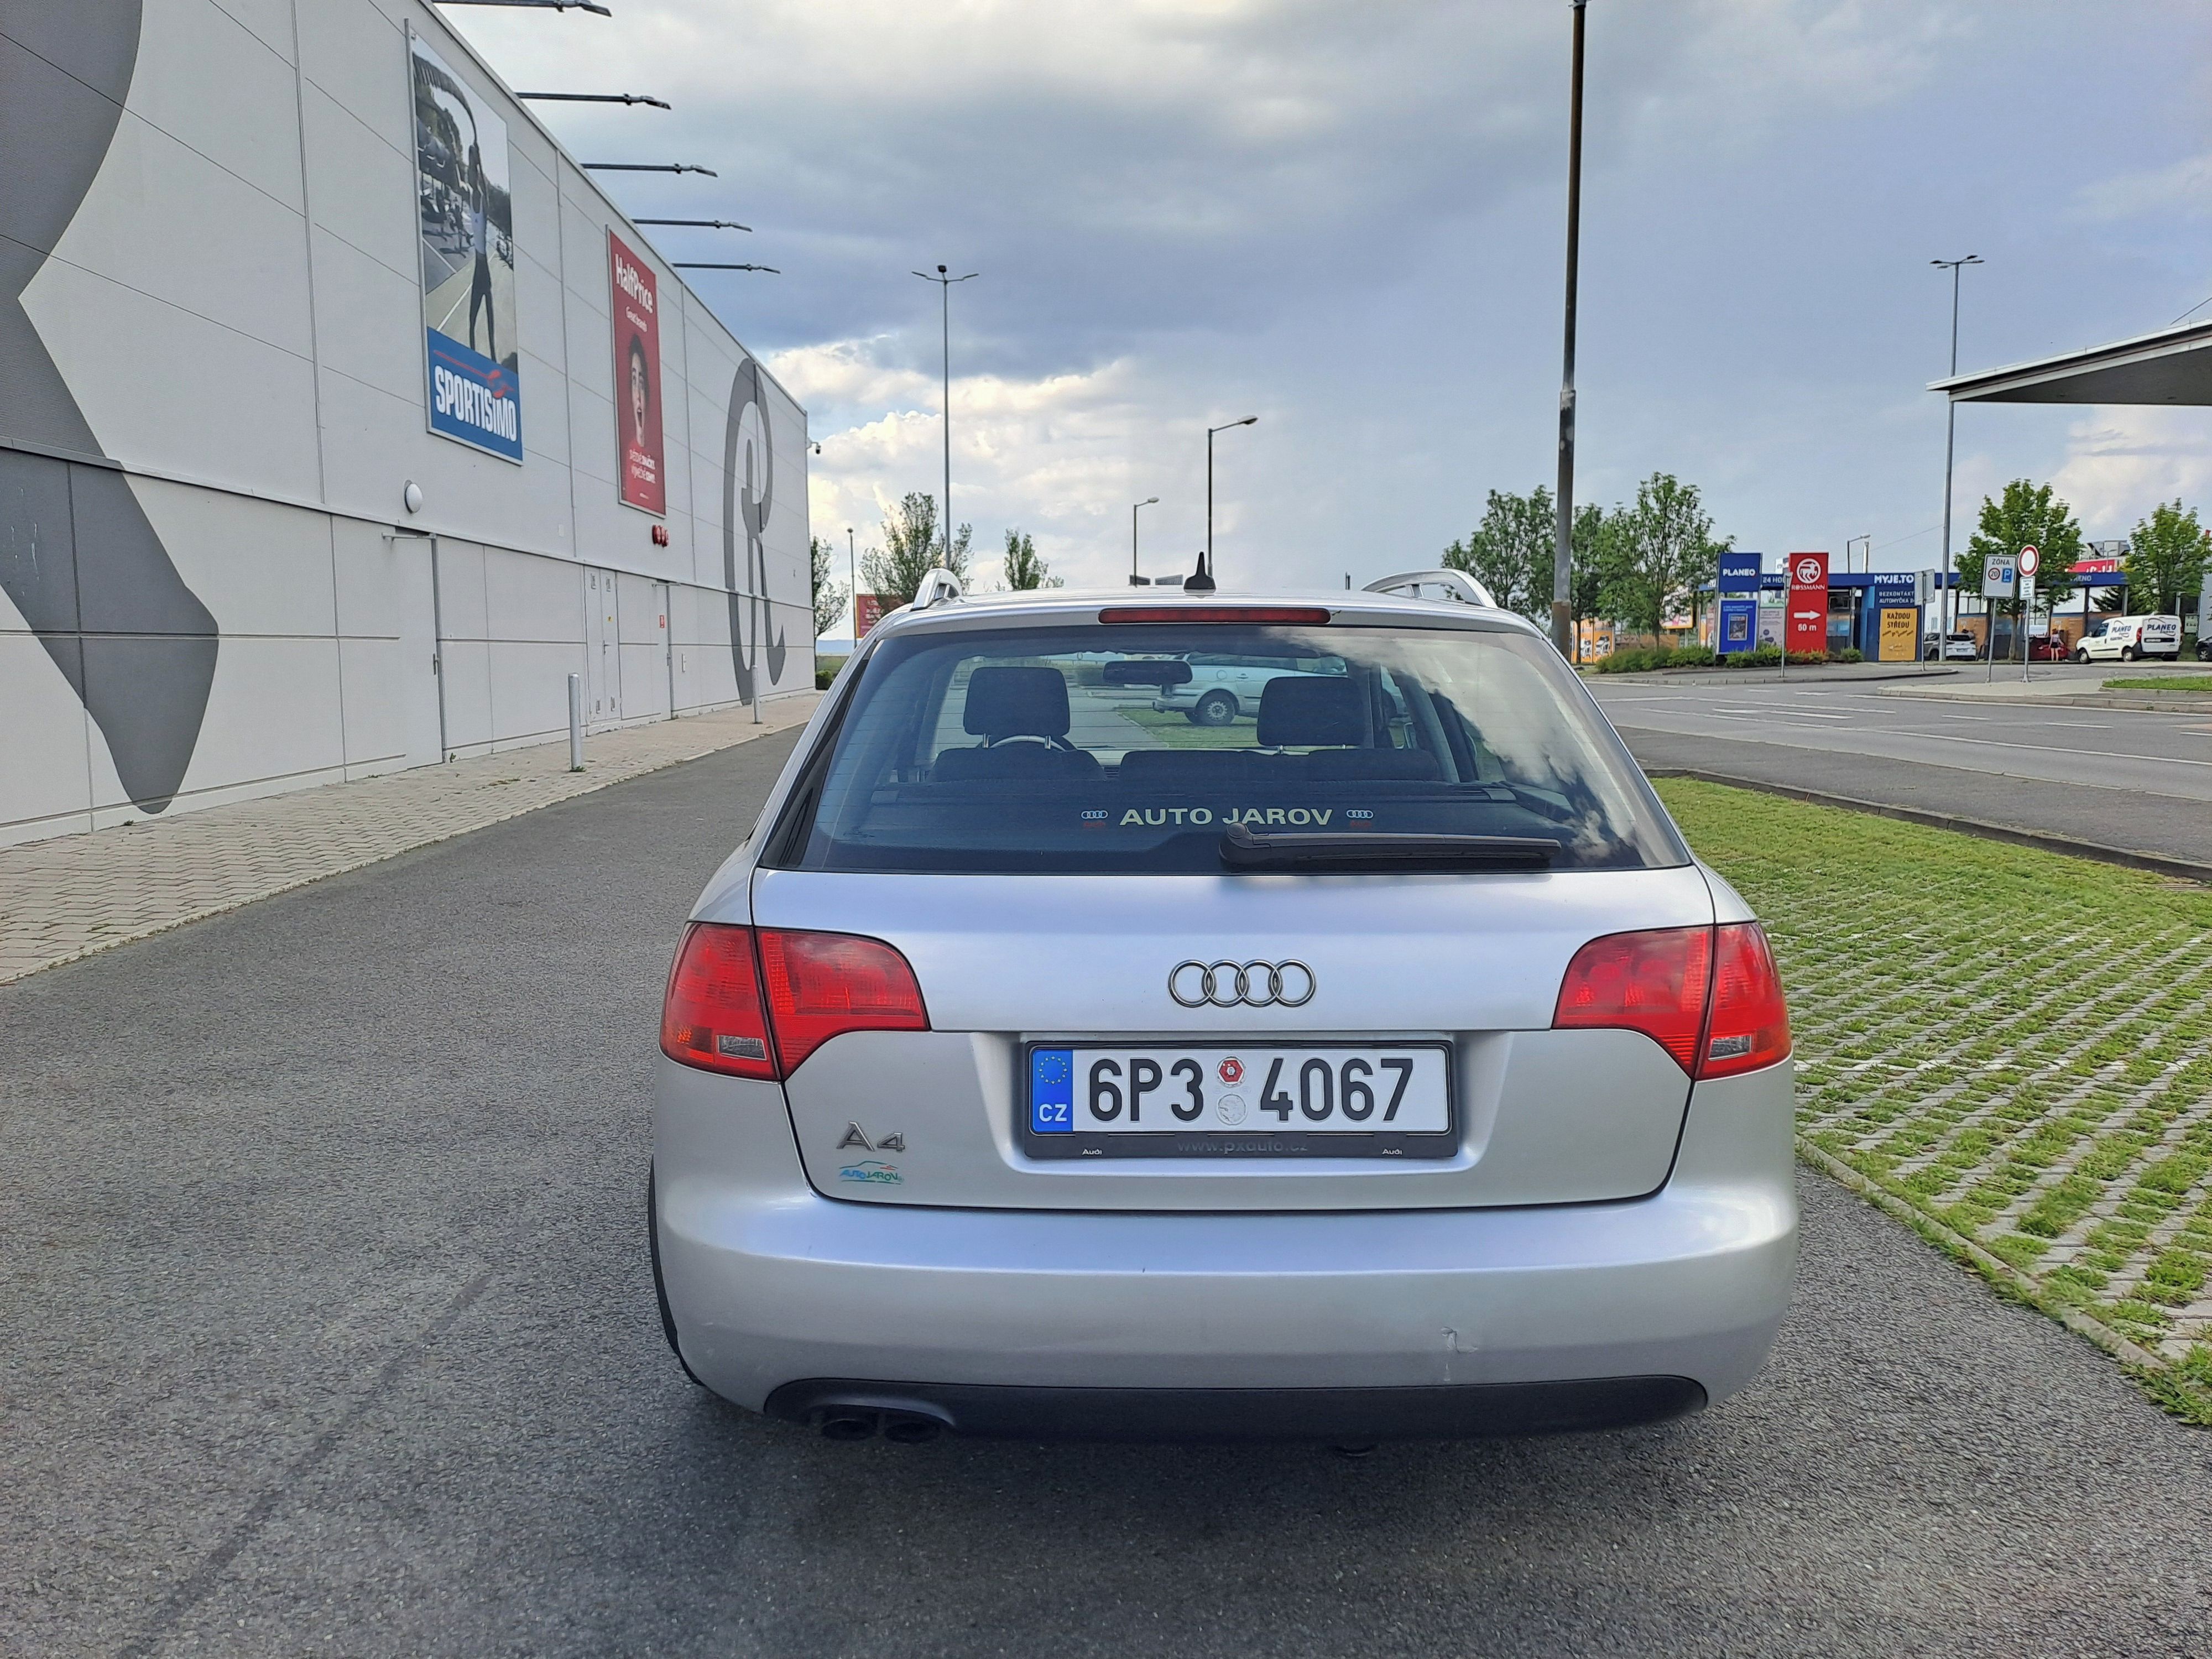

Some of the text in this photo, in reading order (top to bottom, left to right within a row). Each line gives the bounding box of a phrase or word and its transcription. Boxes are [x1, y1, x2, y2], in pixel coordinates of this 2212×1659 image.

[615, 253, 653, 314] HalfPrice
[434, 364, 517, 442] SPORTISIMO
[1723, 568, 1756, 577] PLANEO
[1874, 575, 1914, 584] MYJE.TO
[1119, 807, 1333, 826] AUTO JAROV
[1089, 1057, 1414, 1122] 6P3 4067
[1039, 1103, 1067, 1121] CZ
[836, 1120, 906, 1152] A4
